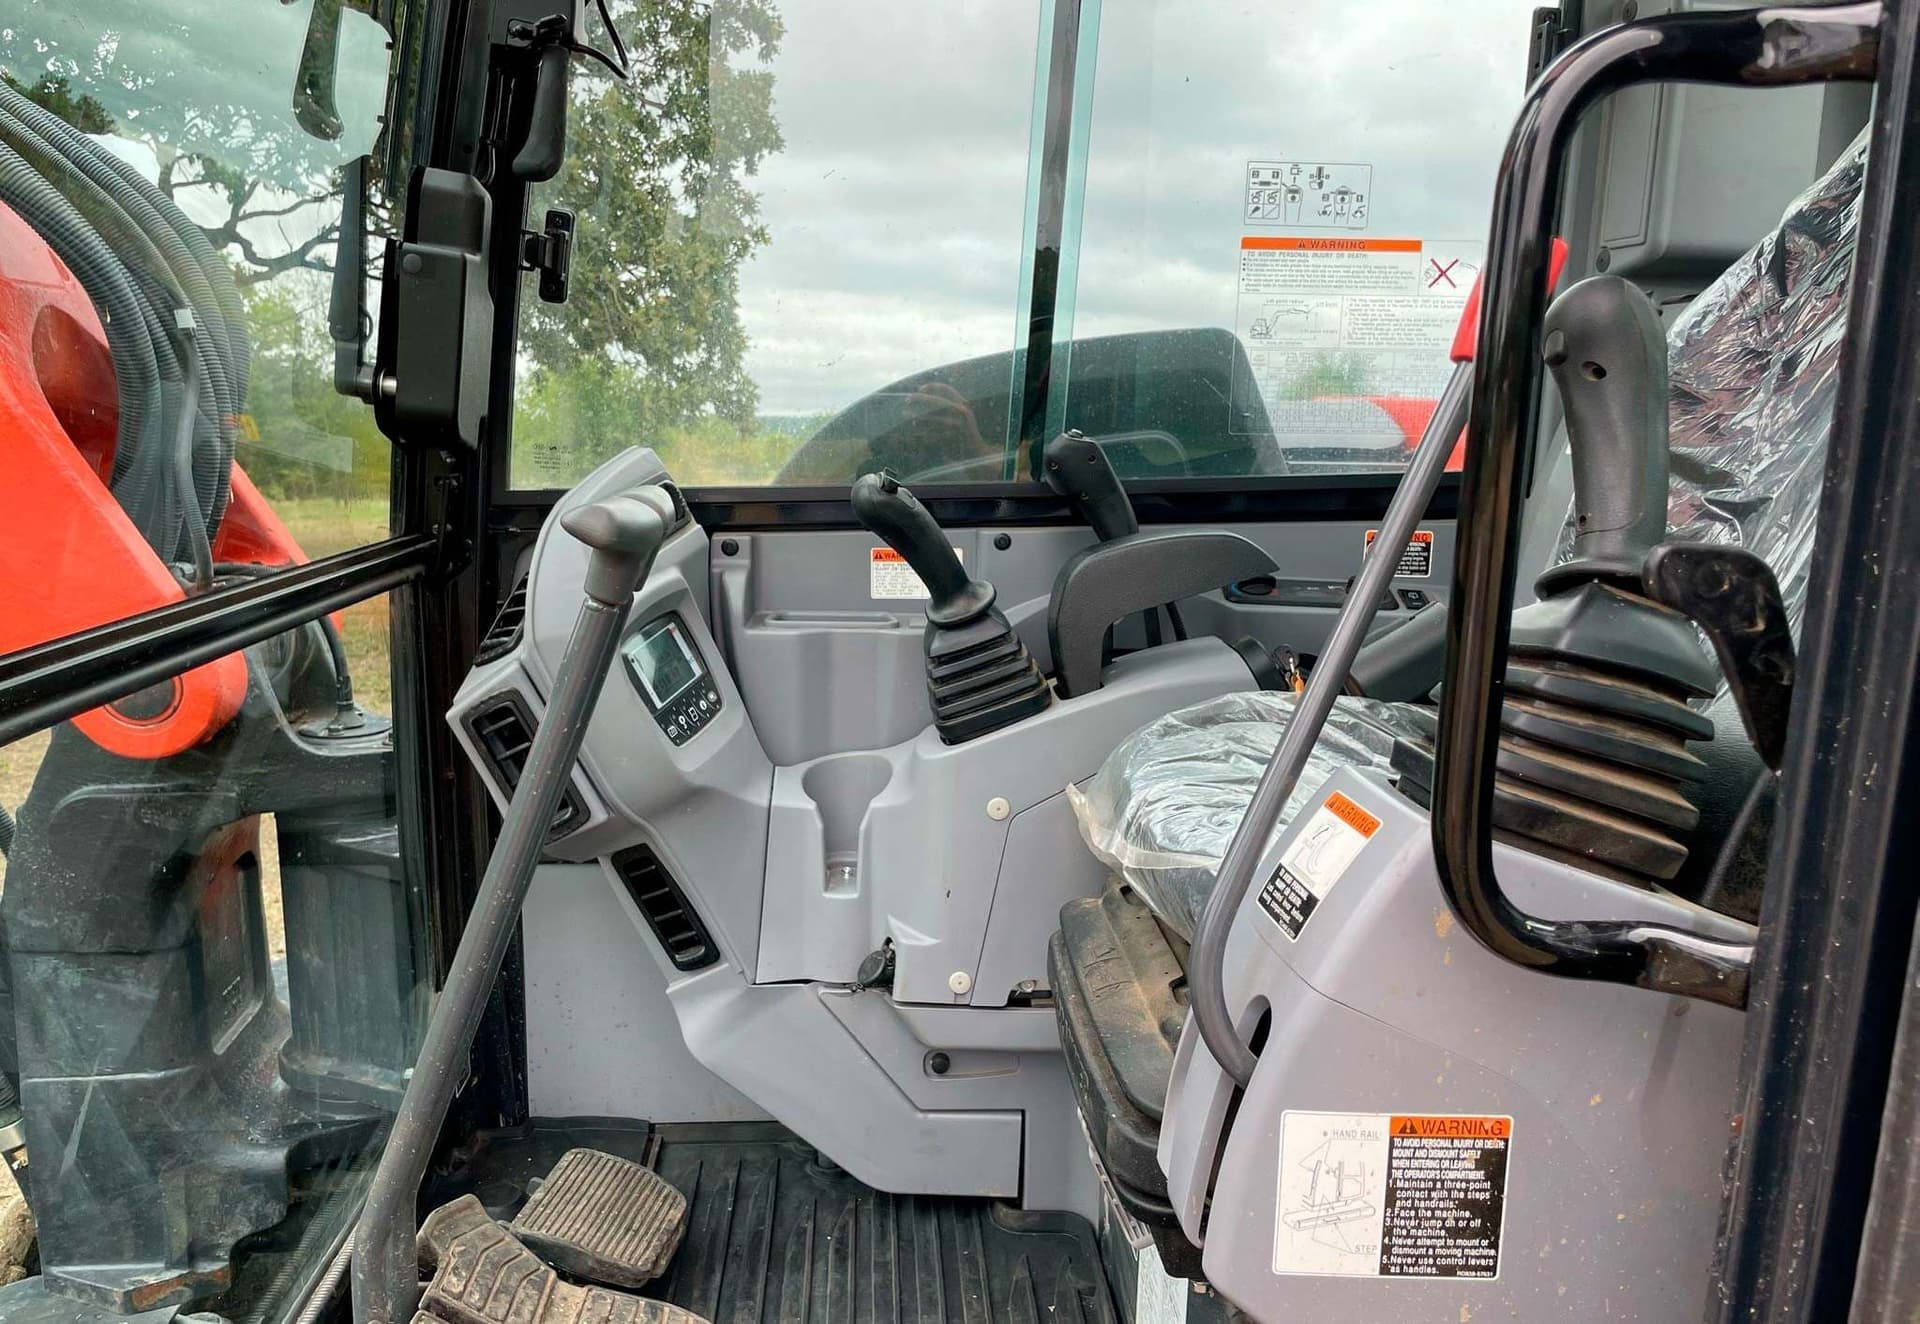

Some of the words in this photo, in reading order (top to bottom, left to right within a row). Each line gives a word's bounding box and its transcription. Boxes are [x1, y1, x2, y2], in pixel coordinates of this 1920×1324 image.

[1311, 240, 1366, 249] WARNING
[1336, 800, 1375, 833] WARNING
[1421, 1120, 1502, 1136] WARNING
[1332, 1129, 1358, 1138] HAND
[1360, 1130, 1380, 1139] RAIL
[1394, 1138, 1402, 1147] TO
[1403, 1138, 1420, 1147] AVOID
[1421, 1139, 1452, 1148] PERSONAL
[1453, 1139, 1474, 1148] INJURY
[1475, 1140, 1484, 1148] OR
[1392, 1148, 1413, 1158] MOUNT
[1415, 1149, 1427, 1158] AND
[1428, 1149, 1459, 1159] DISMOUNT
[1460, 1149, 1481, 1159] SAFELY
[1392, 1159, 1410, 1168] WHEN
[1411, 1159, 1440, 1169] ENTERING
[1441, 1160, 1450, 1169] OR
[1392, 1169, 1403, 1178] THE
[1404, 1170, 1440, 1179] OPERATOR'S
[1444, 1180, 1491, 1190] three-point
[1396, 1190, 1428, 1198] contact
[1431, 1190, 1448, 1199] with
[1451, 1190, 1465, 1199] the
[1467, 1191, 1490, 1200] steps
[1396, 1199, 1411, 1207] and
[1414, 1199, 1457, 1208] handrails.
[1418, 1208, 1432, 1217] the
[1434, 1209, 1473, 1218] machine.
[1421, 1219, 1442, 1228] jump
[1470, 1219, 1481, 1227] off
[1393, 1228, 1407, 1236] the
[1410, 1228, 1448, 1237] machine.
[1416, 1238, 1445, 1247] attempt
[1446, 1238, 1454, 1246] to
[1456, 1239, 1479, 1247] mount
[1480, 1239, 1489, 1247] or
[1355, 1244, 1377, 1253] STEP
[1391, 1247, 1426, 1255] dismount
[1435, 1248, 1462, 1257] moving
[1464, 1248, 1497, 1256] machine.
[1436, 1256, 1466, 1265] control
[1468, 1256, 1494, 1266] levers
[1403, 1265, 1440, 1274] handles.
